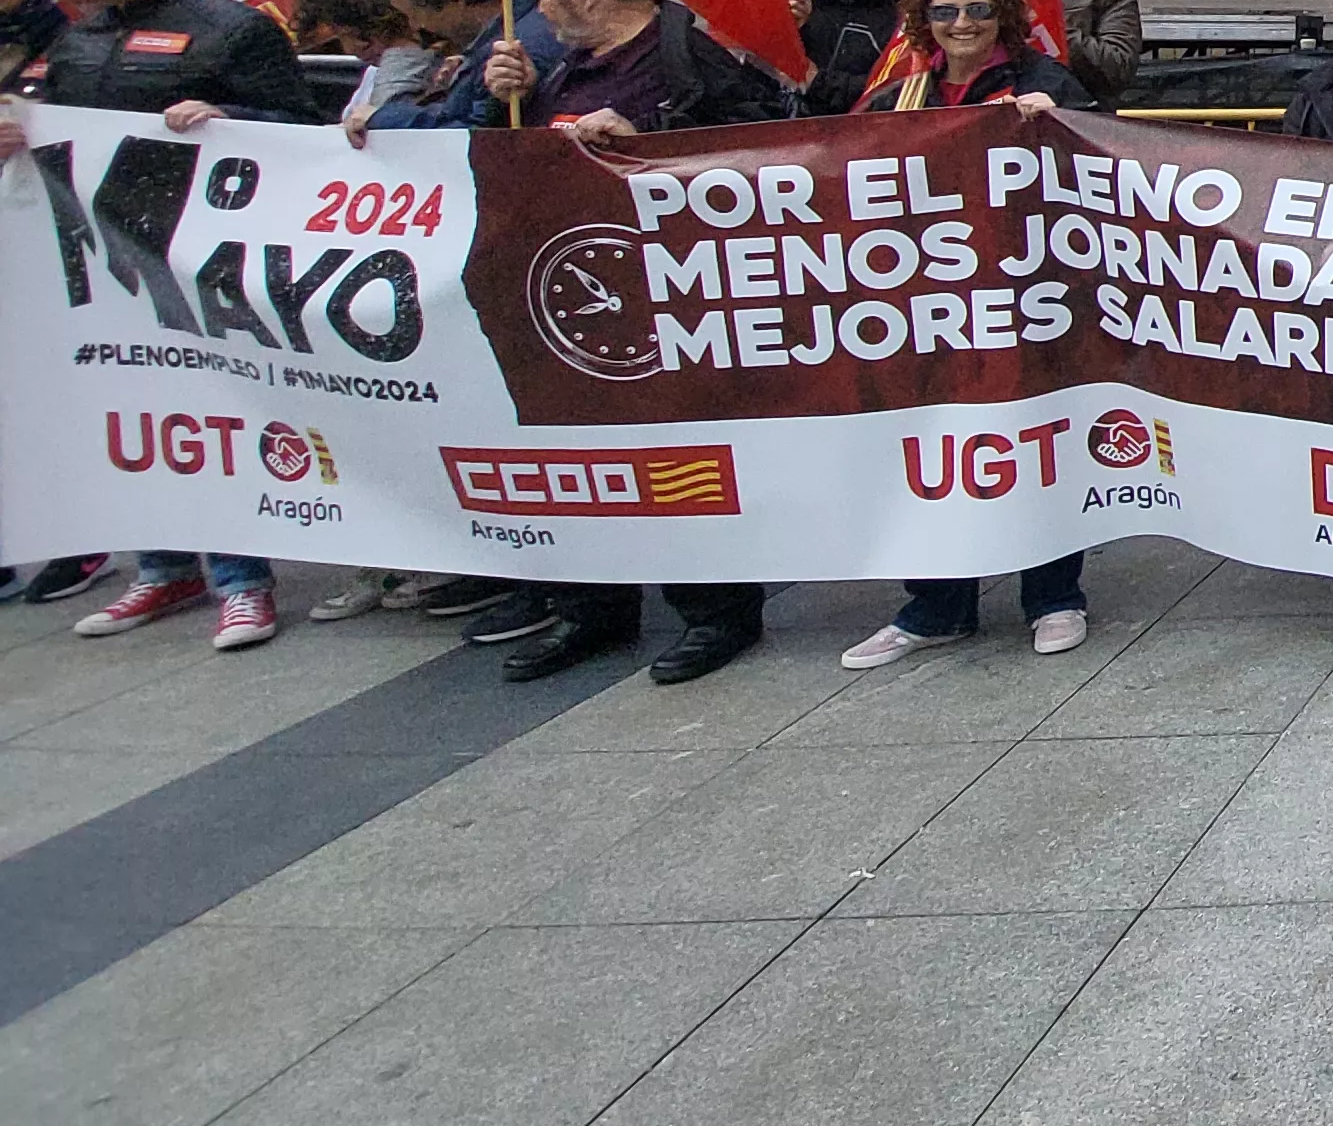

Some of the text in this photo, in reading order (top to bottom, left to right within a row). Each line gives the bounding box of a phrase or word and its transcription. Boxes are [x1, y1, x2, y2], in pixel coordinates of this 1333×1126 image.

[304, 180, 444, 238] 2024
[627, 164, 823, 232] POR
[847, 155, 964, 221] EL
[987, 145, 1242, 227] PLENO
[642, 220, 979, 303] MENOS
[653, 281, 1073, 372] MEJORES
[74, 343, 261, 381] #PLENOEMPLEO
[283, 366, 440, 404] #1MAYO2024
[105, 411, 245, 478] UGT
[901, 418, 1071, 503] UGT
[257, 492, 343, 526] Aragón
[454, 461, 641, 504] CCOO
[1080, 483, 1183, 514] Aragón
[471, 519, 556, 548] Aragón
